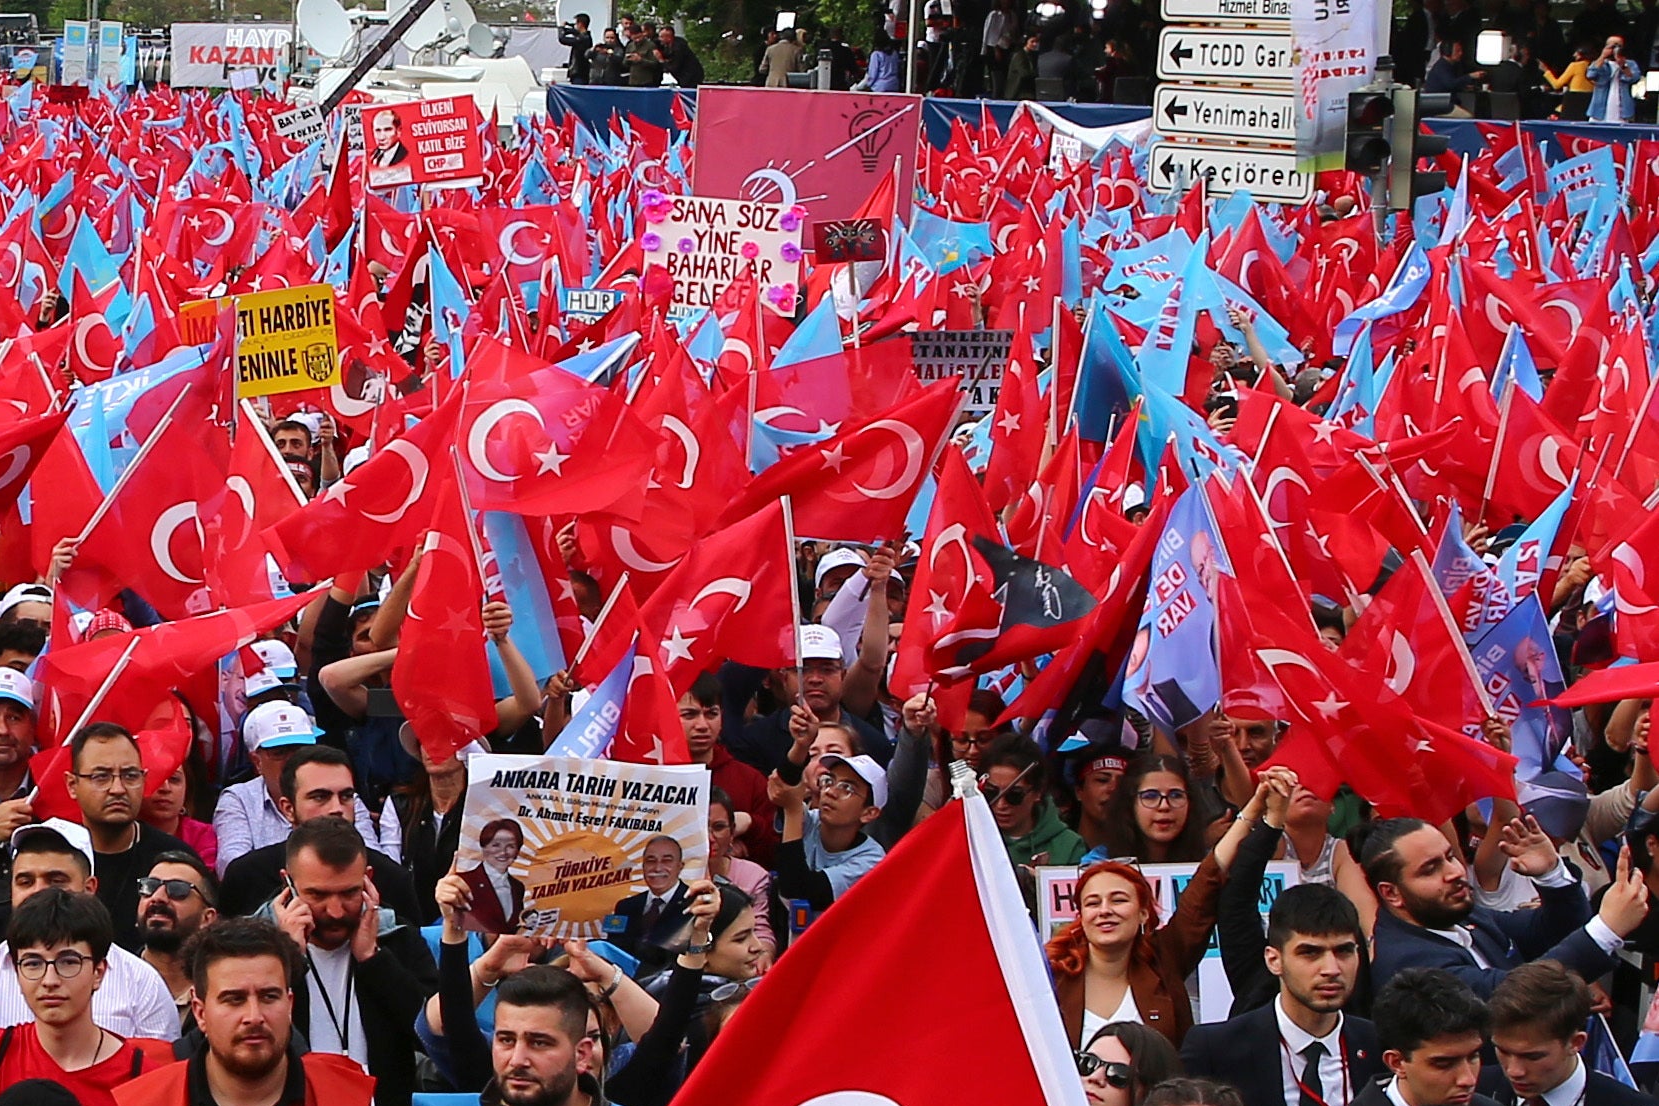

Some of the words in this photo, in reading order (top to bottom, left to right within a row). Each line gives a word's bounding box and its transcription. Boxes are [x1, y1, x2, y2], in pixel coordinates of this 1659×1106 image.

[1200, 44, 1244, 66] TCDD
[421, 101, 454, 117] ÜLKENİ
[1194, 101, 1300, 130] Yenimahalle
[411, 117, 468, 137] SEVİYORSAN
[417, 138, 445, 154] KATIL
[444, 136, 467, 150] BİZE
[1190, 157, 1302, 187] Keçiören
[671, 198, 726, 225] SANA
[737, 203, 780, 232] SÖZ
[693, 225, 741, 255] YİNE
[259, 295, 332, 335] HARBİYE
[237, 346, 298, 383] ENİNLE
[490, 770, 561, 790] ANKARA
[565, 773, 617, 798] TARİH
[620, 780, 699, 806] YAZACAK
[517, 805, 534, 818] Dr.
[536, 807, 573, 823] Ahmet
[575, 811, 607, 828] Eşref
[607, 816, 663, 832] FAKIBABA
[554, 855, 612, 880] TÜRKİYE
[531, 878, 570, 900] TARİH
[571, 867, 633, 893] YAZACAK
